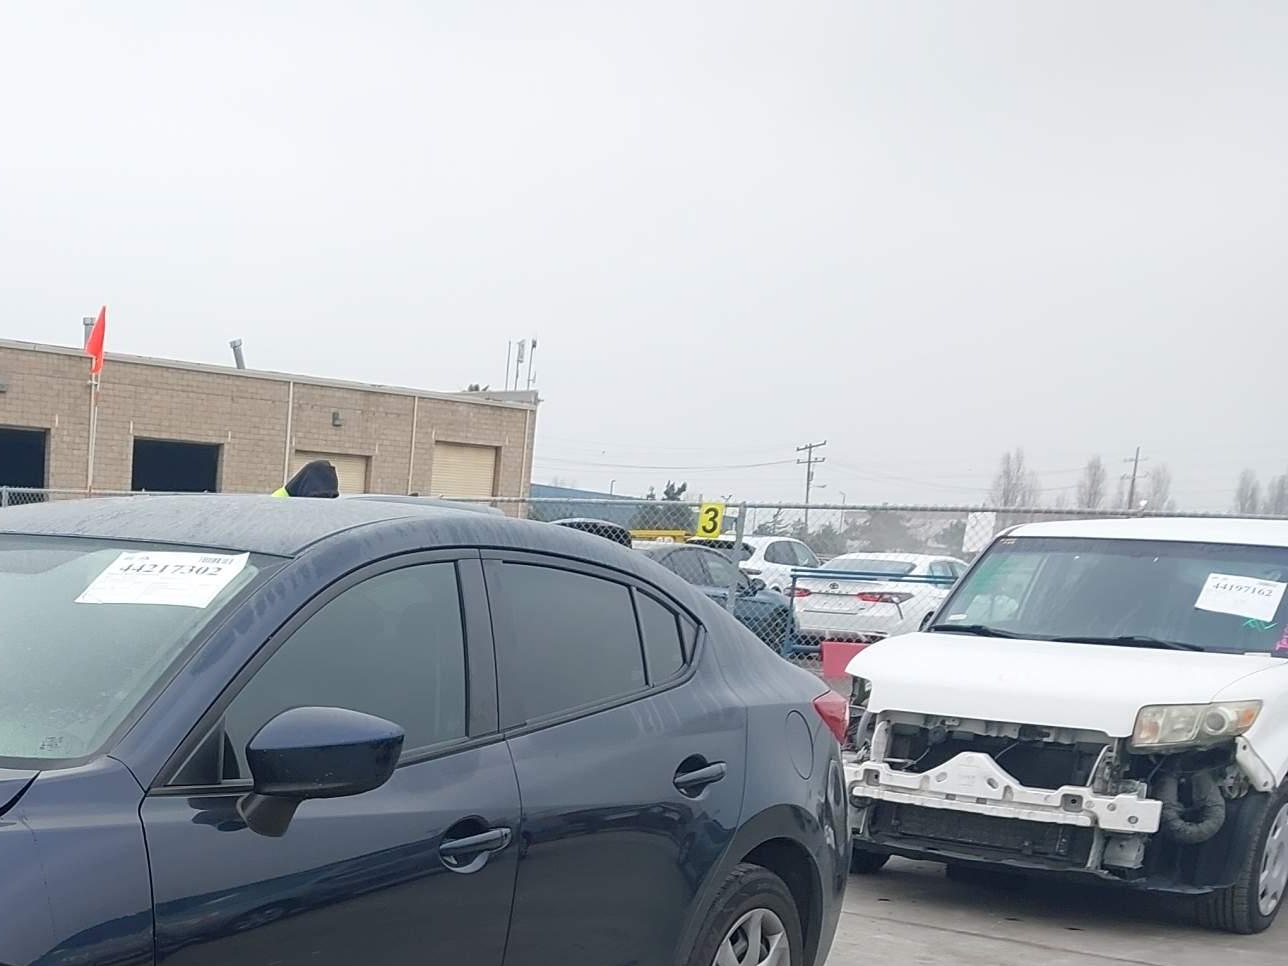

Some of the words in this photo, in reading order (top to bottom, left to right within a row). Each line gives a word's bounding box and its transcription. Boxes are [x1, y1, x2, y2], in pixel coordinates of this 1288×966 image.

[701, 507, 719, 534] 3
[119, 563, 224, 576] 44217302
[1212, 582, 1273, 597] 44197162
